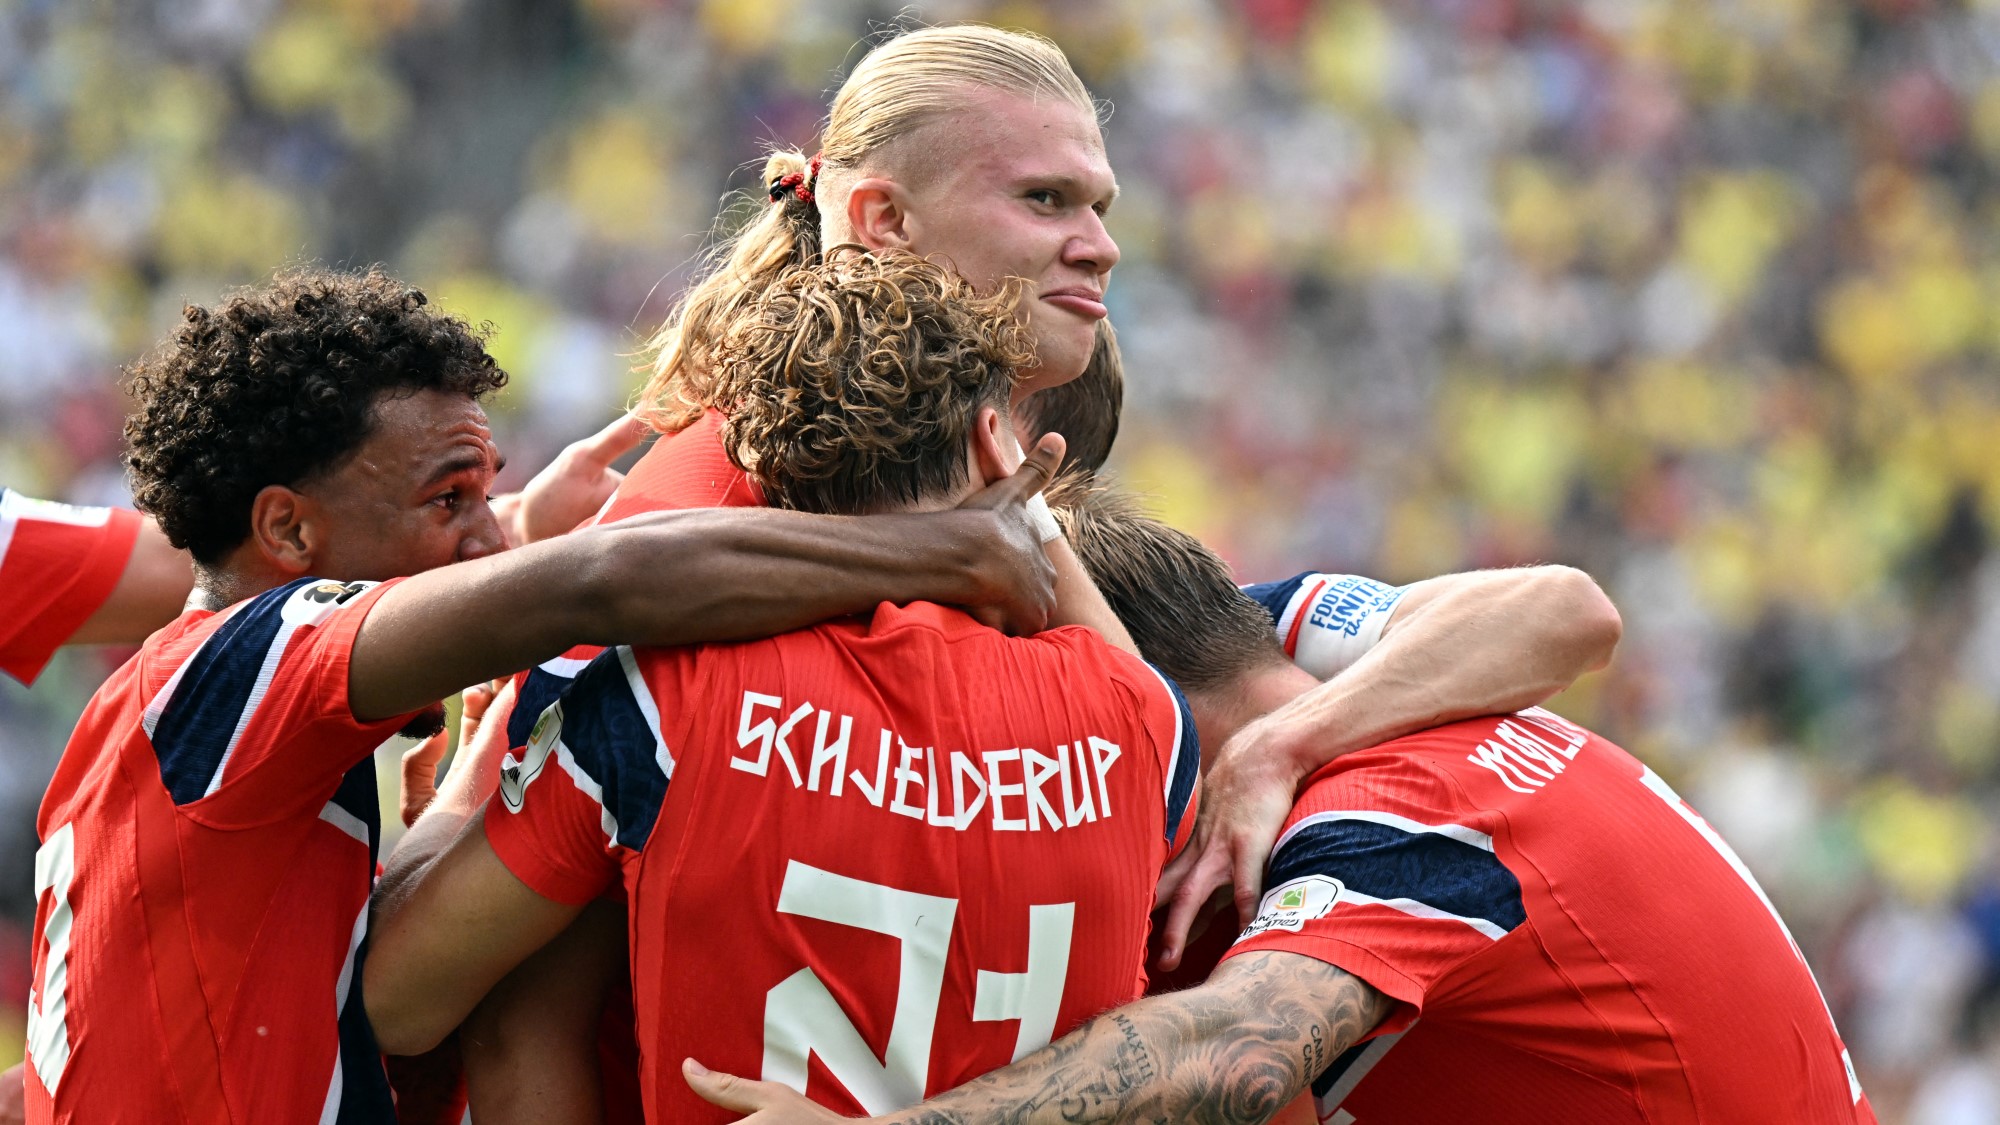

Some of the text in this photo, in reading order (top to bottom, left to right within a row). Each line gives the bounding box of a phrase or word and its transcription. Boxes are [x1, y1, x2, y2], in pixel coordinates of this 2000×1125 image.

[1343, 608, 1371, 639] the
[730, 690, 1122, 832] SCHJELDERUP
[761, 858, 1076, 1117] 21
[1112, 1013, 1155, 1081] MMXIII
